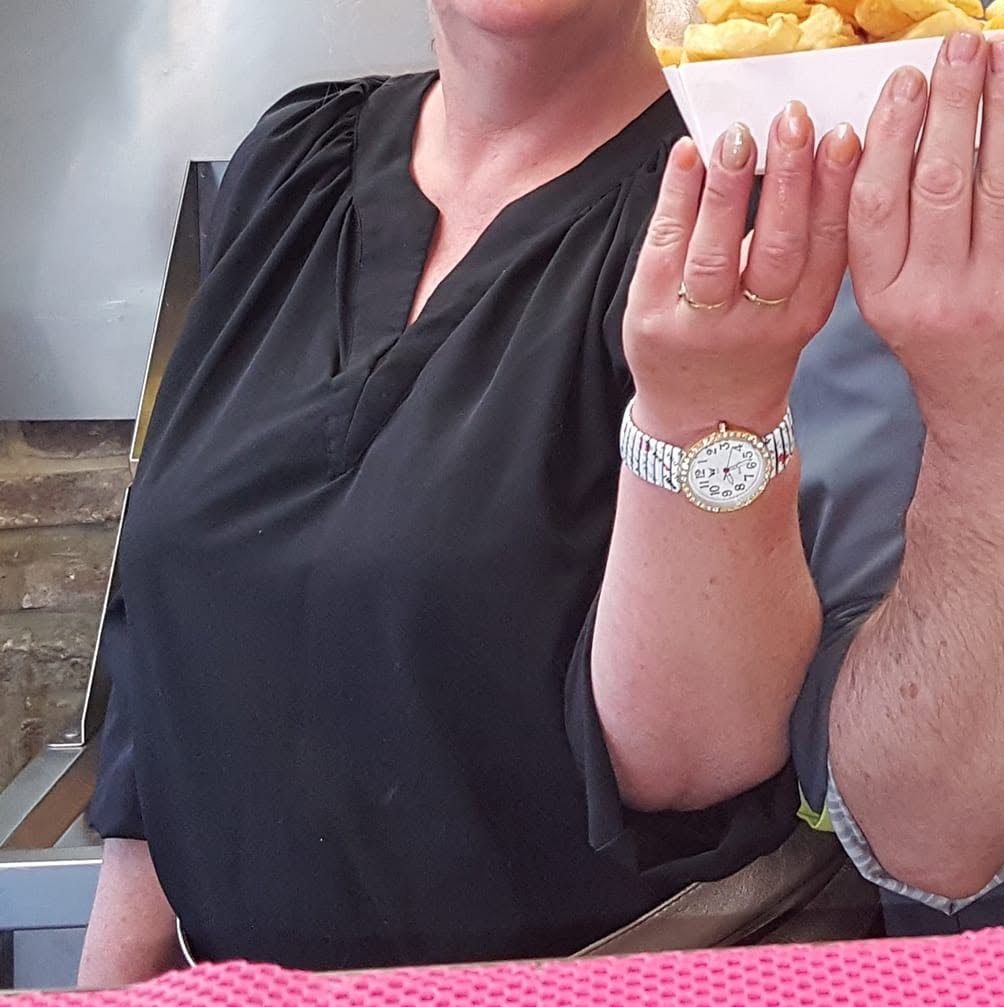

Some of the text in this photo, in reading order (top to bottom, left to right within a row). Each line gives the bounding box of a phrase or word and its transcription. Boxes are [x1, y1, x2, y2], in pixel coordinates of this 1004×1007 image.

[720, 442, 730, 450] 3
[732, 444, 743, 452] 4
[695, 469, 705, 479] 12
[744, 474, 754, 482] 7
[709, 485, 721, 496] 10
[735, 483, 745, 491] 8
